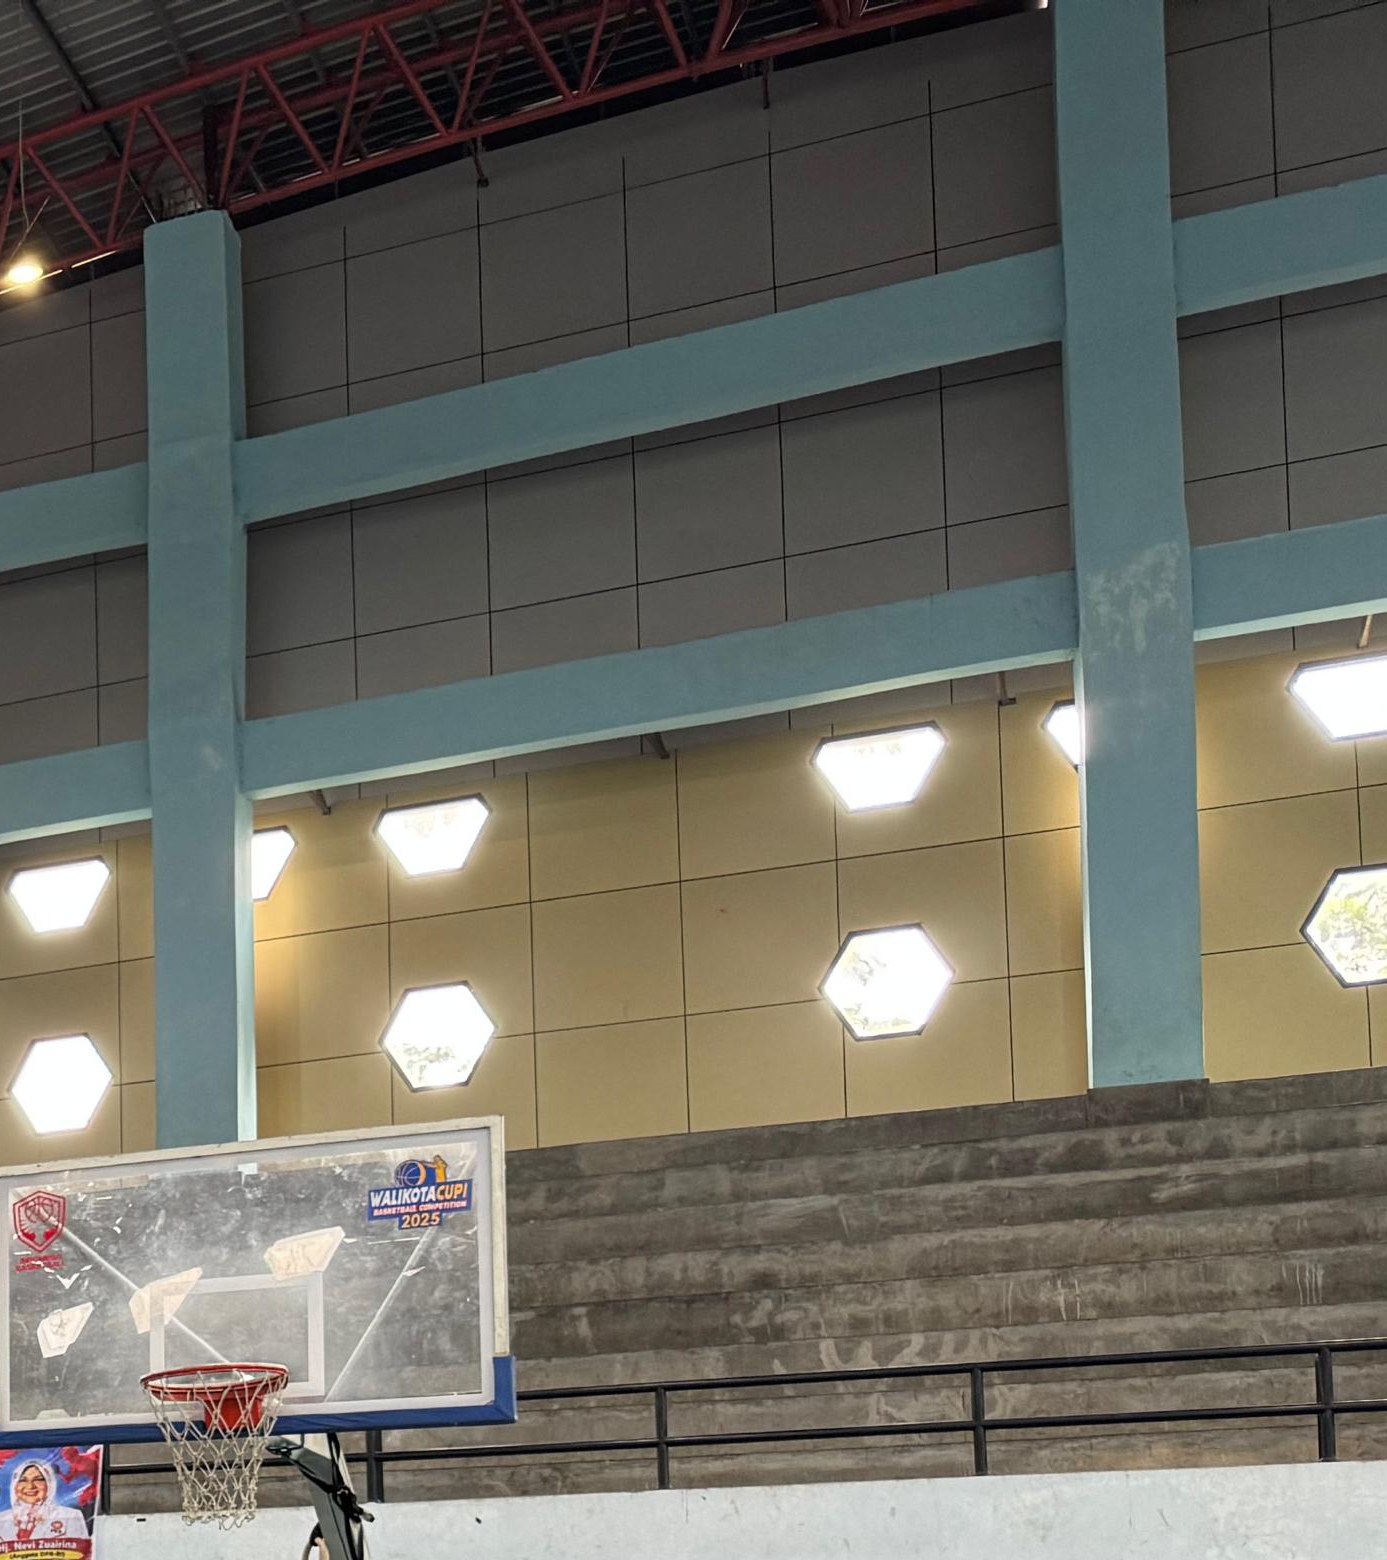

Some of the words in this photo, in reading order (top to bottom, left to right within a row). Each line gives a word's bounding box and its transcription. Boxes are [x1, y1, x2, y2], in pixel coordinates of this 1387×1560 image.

[370, 1186, 436, 1207] WALIKOTA
[401, 1212, 440, 1228] 2025
[14, 1541, 35, 1550] Nevi
[38, 1540, 77, 1549] Zuairina
